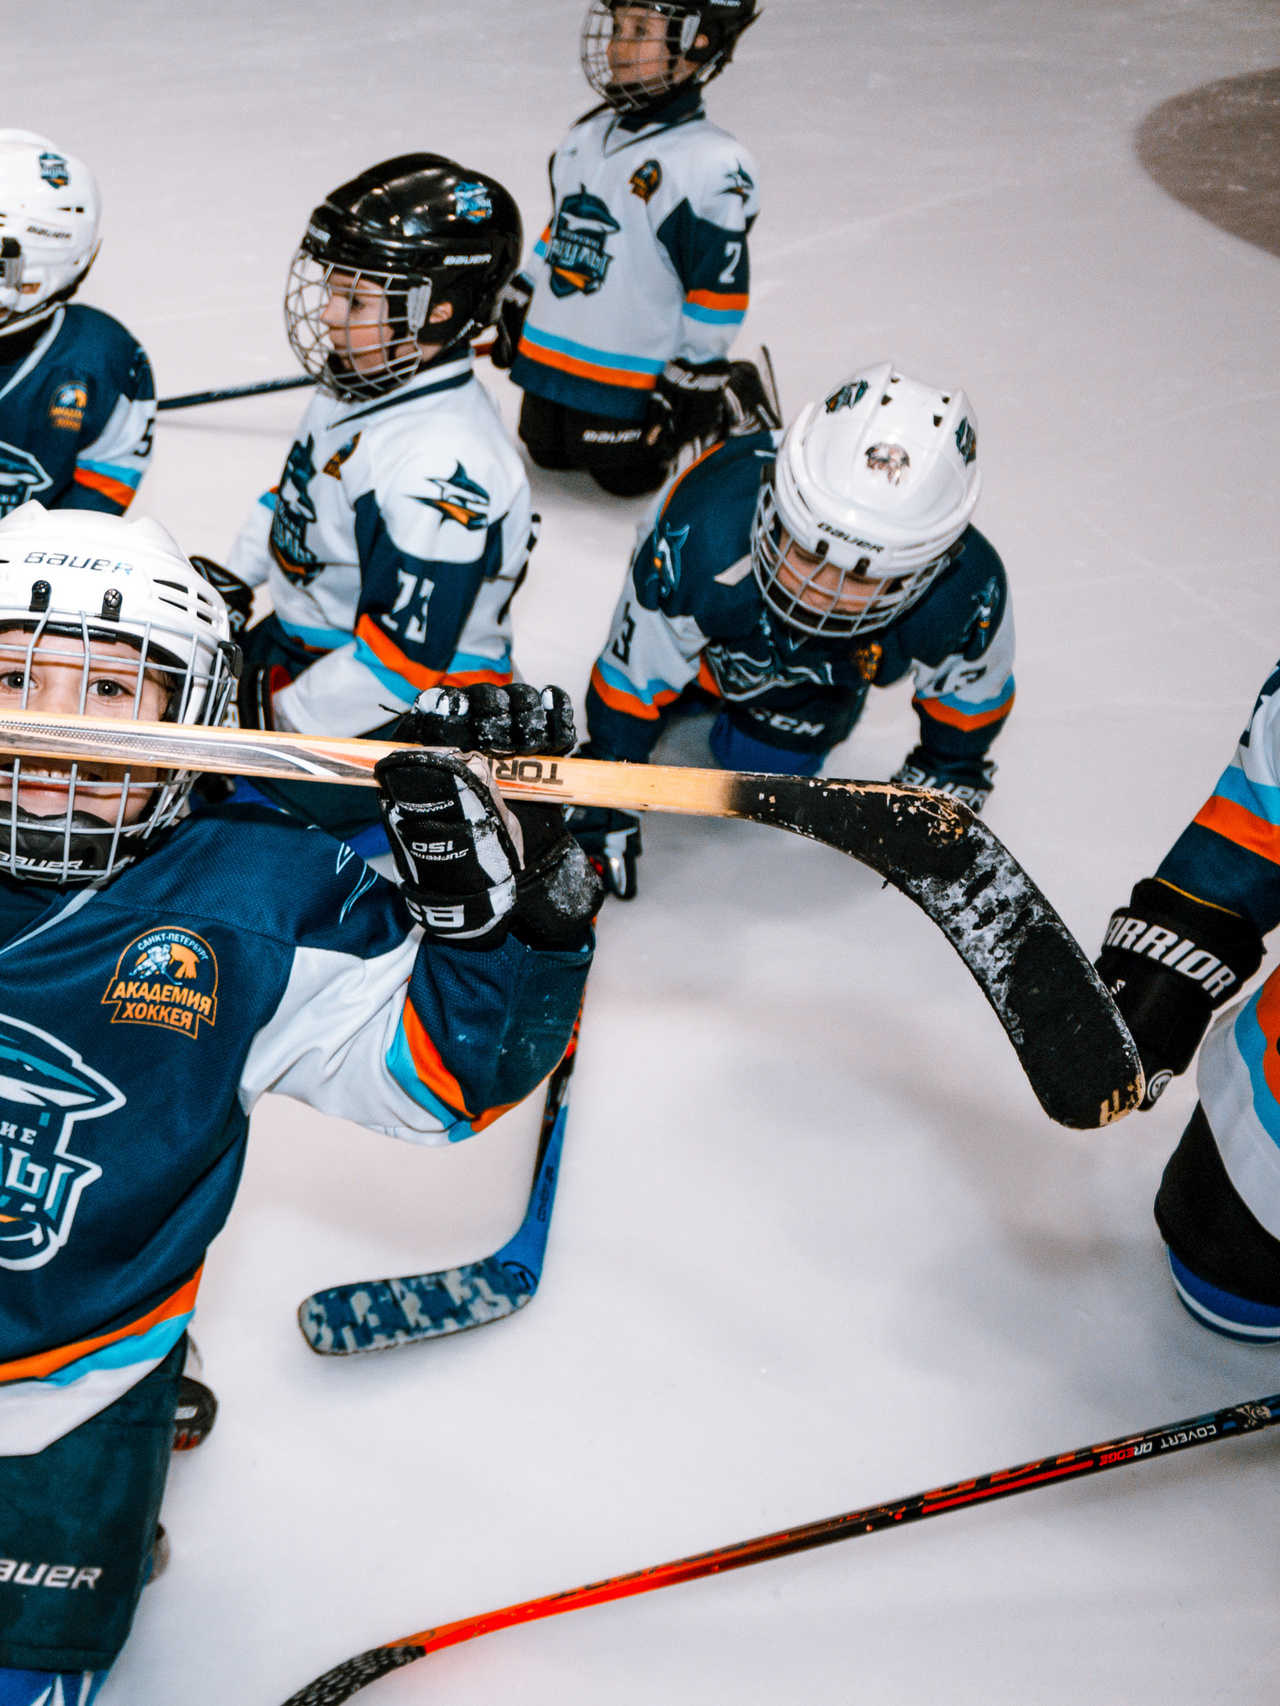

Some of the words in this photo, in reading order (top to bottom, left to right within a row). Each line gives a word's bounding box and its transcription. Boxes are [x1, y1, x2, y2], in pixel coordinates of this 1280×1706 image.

[1102, 916, 1237, 999] ARRIOR
[111, 981, 213, 1017] АКАДЕМИЯ
[121, 1001, 194, 1031] ХОККЕЯ
[1160, 1424, 1217, 1449] COVERT
